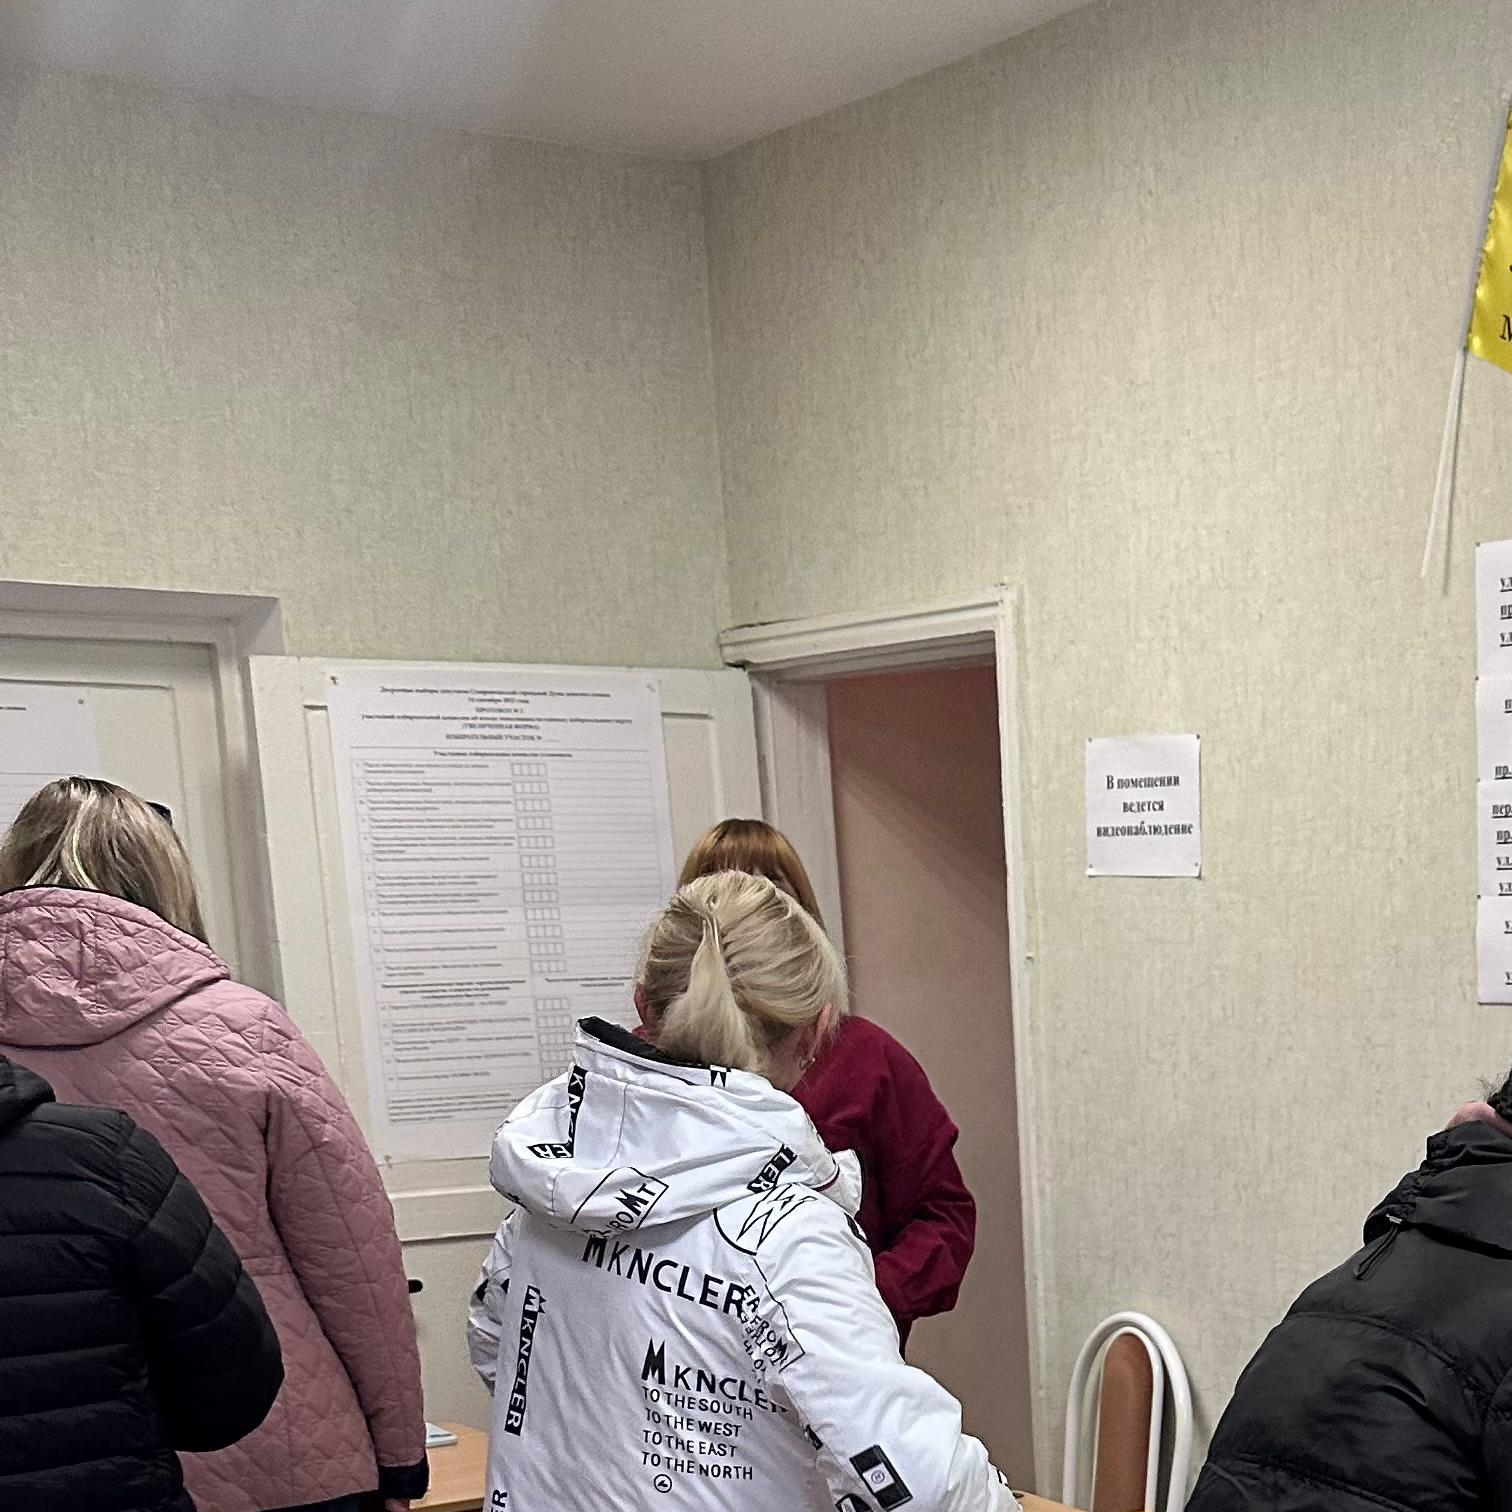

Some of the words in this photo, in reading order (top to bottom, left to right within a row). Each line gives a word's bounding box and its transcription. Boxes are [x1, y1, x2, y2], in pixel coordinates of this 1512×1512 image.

[1106, 775, 1114, 790] В
[1123, 800, 1164, 813] ведется
[1096, 821, 1194, 837] видеонаблюдение
[507, 1288, 547, 1428] MKNCLER
[642, 1386, 660, 1402] TO
[664, 1391, 696, 1410] THE
[699, 1399, 753, 1421] SOUTH
[645, 1407, 661, 1424] TO
[664, 1415, 695, 1431] THE
[698, 1420, 742, 1437] WEST
[643, 1430, 662, 1445] TO
[665, 1435, 695, 1454] THE
[699, 1441, 738, 1457] EAST
[642, 1451, 661, 1466] TO
[665, 1456, 696, 1474] THE
[699, 1464, 753, 1480] NORTH
